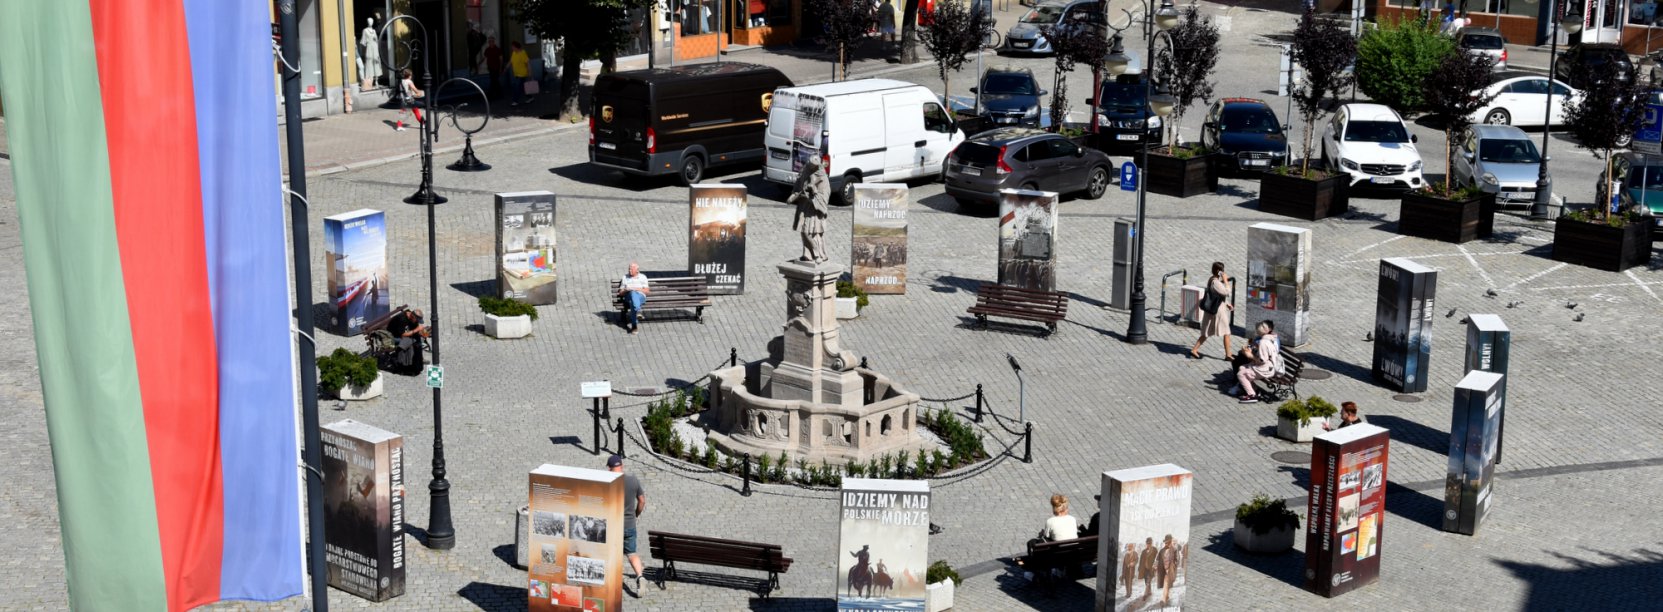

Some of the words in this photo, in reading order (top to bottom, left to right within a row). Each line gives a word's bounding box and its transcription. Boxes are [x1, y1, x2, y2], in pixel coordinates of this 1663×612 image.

[695, 197, 709, 209] NIE
[858, 199, 891, 209] IDZIEMY
[694, 261, 727, 274] DŁUŻEJ
[715, 273, 742, 284] CZEKAĆ
[324, 444, 350, 463] BOGATE
[353, 454, 375, 471] WIANO
[391, 447, 402, 503] PRZYNOSZĄC
[842, 492, 897, 508] IDZIEMY
[902, 494, 929, 509] NAD
[1156, 485, 1188, 501] PRAWO
[392, 503, 402, 533] WIANO
[843, 508, 880, 520] POLSKIE
[881, 510, 928, 526] MORZE
[1322, 514, 1332, 551] NAPRAWIAMY
[393, 534, 403, 569] BOGATE
